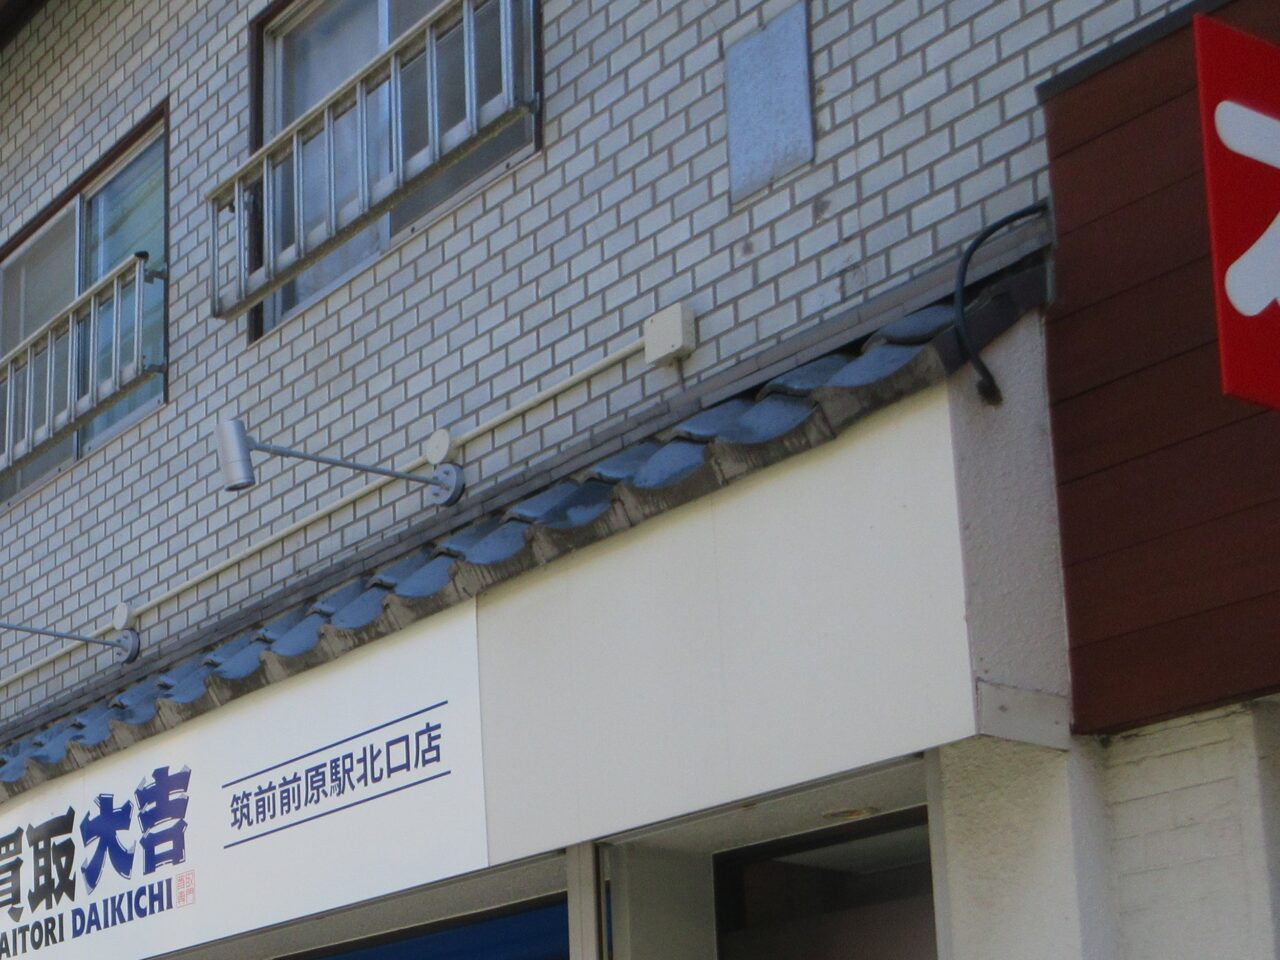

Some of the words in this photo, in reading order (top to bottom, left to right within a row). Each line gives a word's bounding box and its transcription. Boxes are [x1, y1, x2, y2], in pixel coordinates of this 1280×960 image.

[229, 722, 442, 832] 筑前前原駅北口店
[71, 877, 174, 939] DAIKICHI
